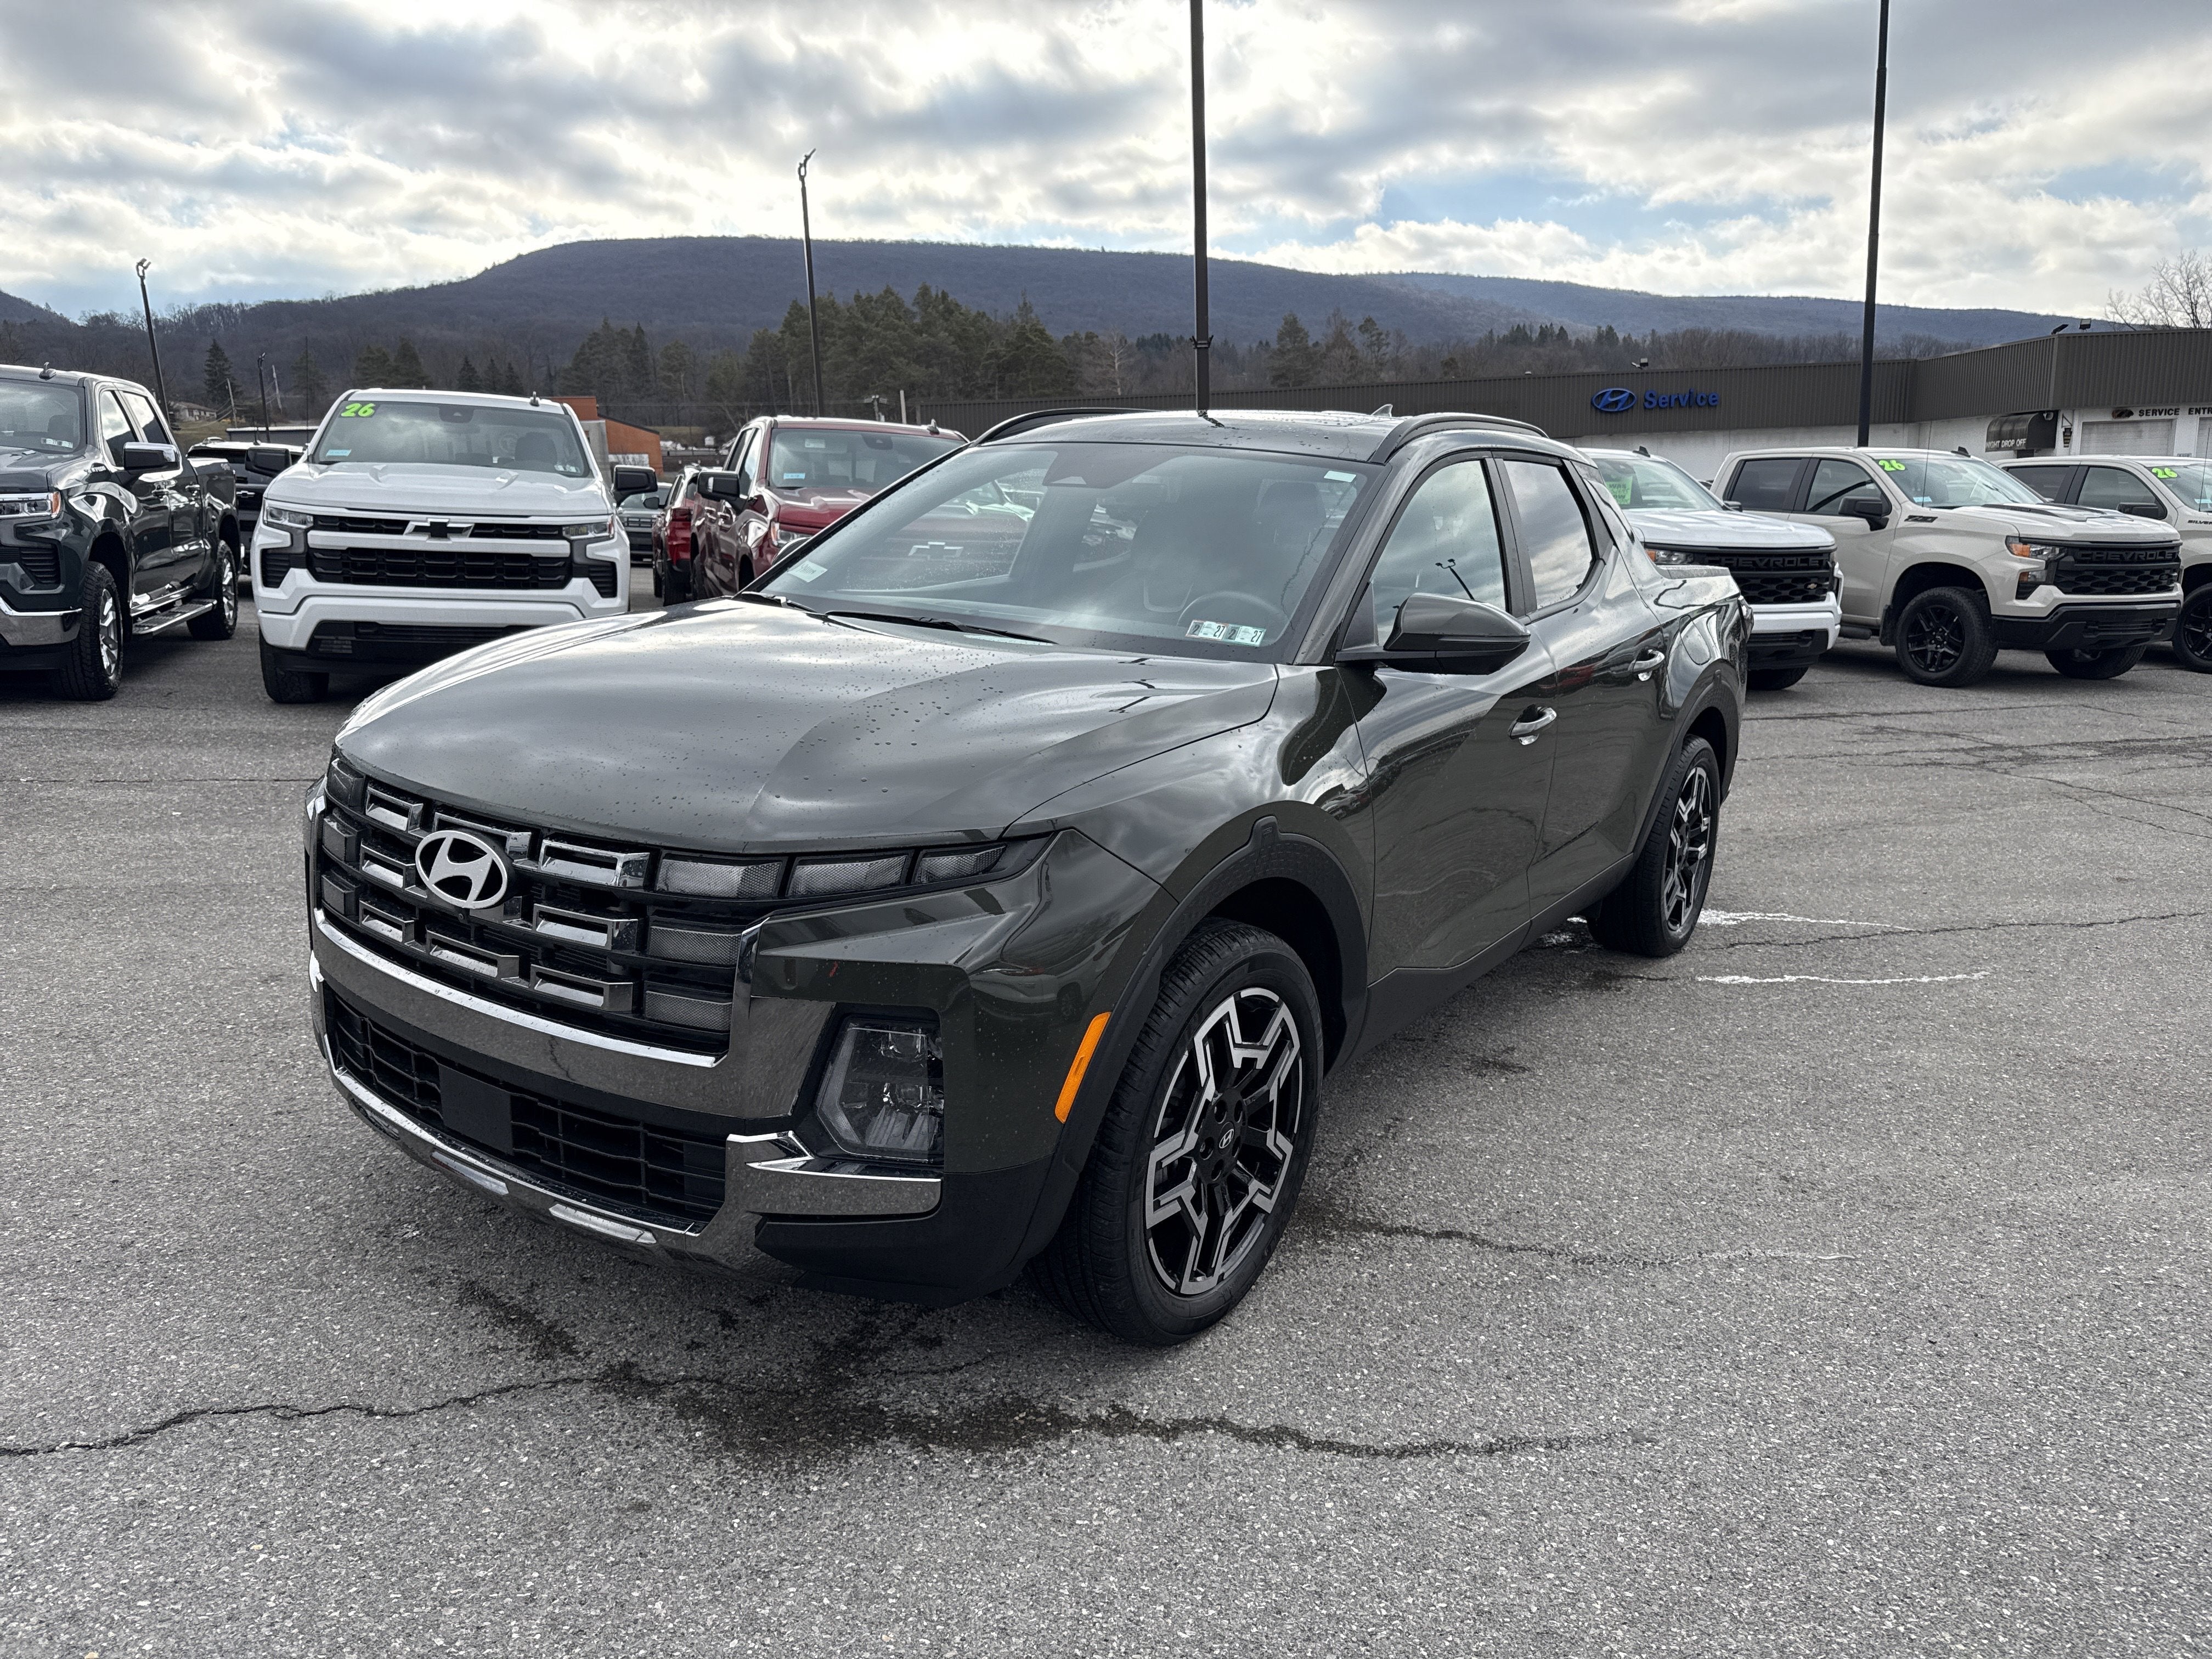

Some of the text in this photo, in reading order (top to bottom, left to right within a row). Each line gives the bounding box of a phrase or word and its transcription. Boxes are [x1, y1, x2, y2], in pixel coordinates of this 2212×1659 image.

[1644, 388, 1719, 409] Service
[341, 403, 376, 417] 26
[2138, 408, 2180, 417] SERVICE
[2001, 439, 2015, 448] DROP
[2016, 438, 2027, 447] OFF
[1878, 460, 1905, 471] 26
[2152, 467, 2178, 478] 26
[2078, 550, 2179, 561] CHEVROLET
[1705, 556, 1829, 568] CHEVROLET
[1192, 624, 1262, 644] 2 27 2 27
